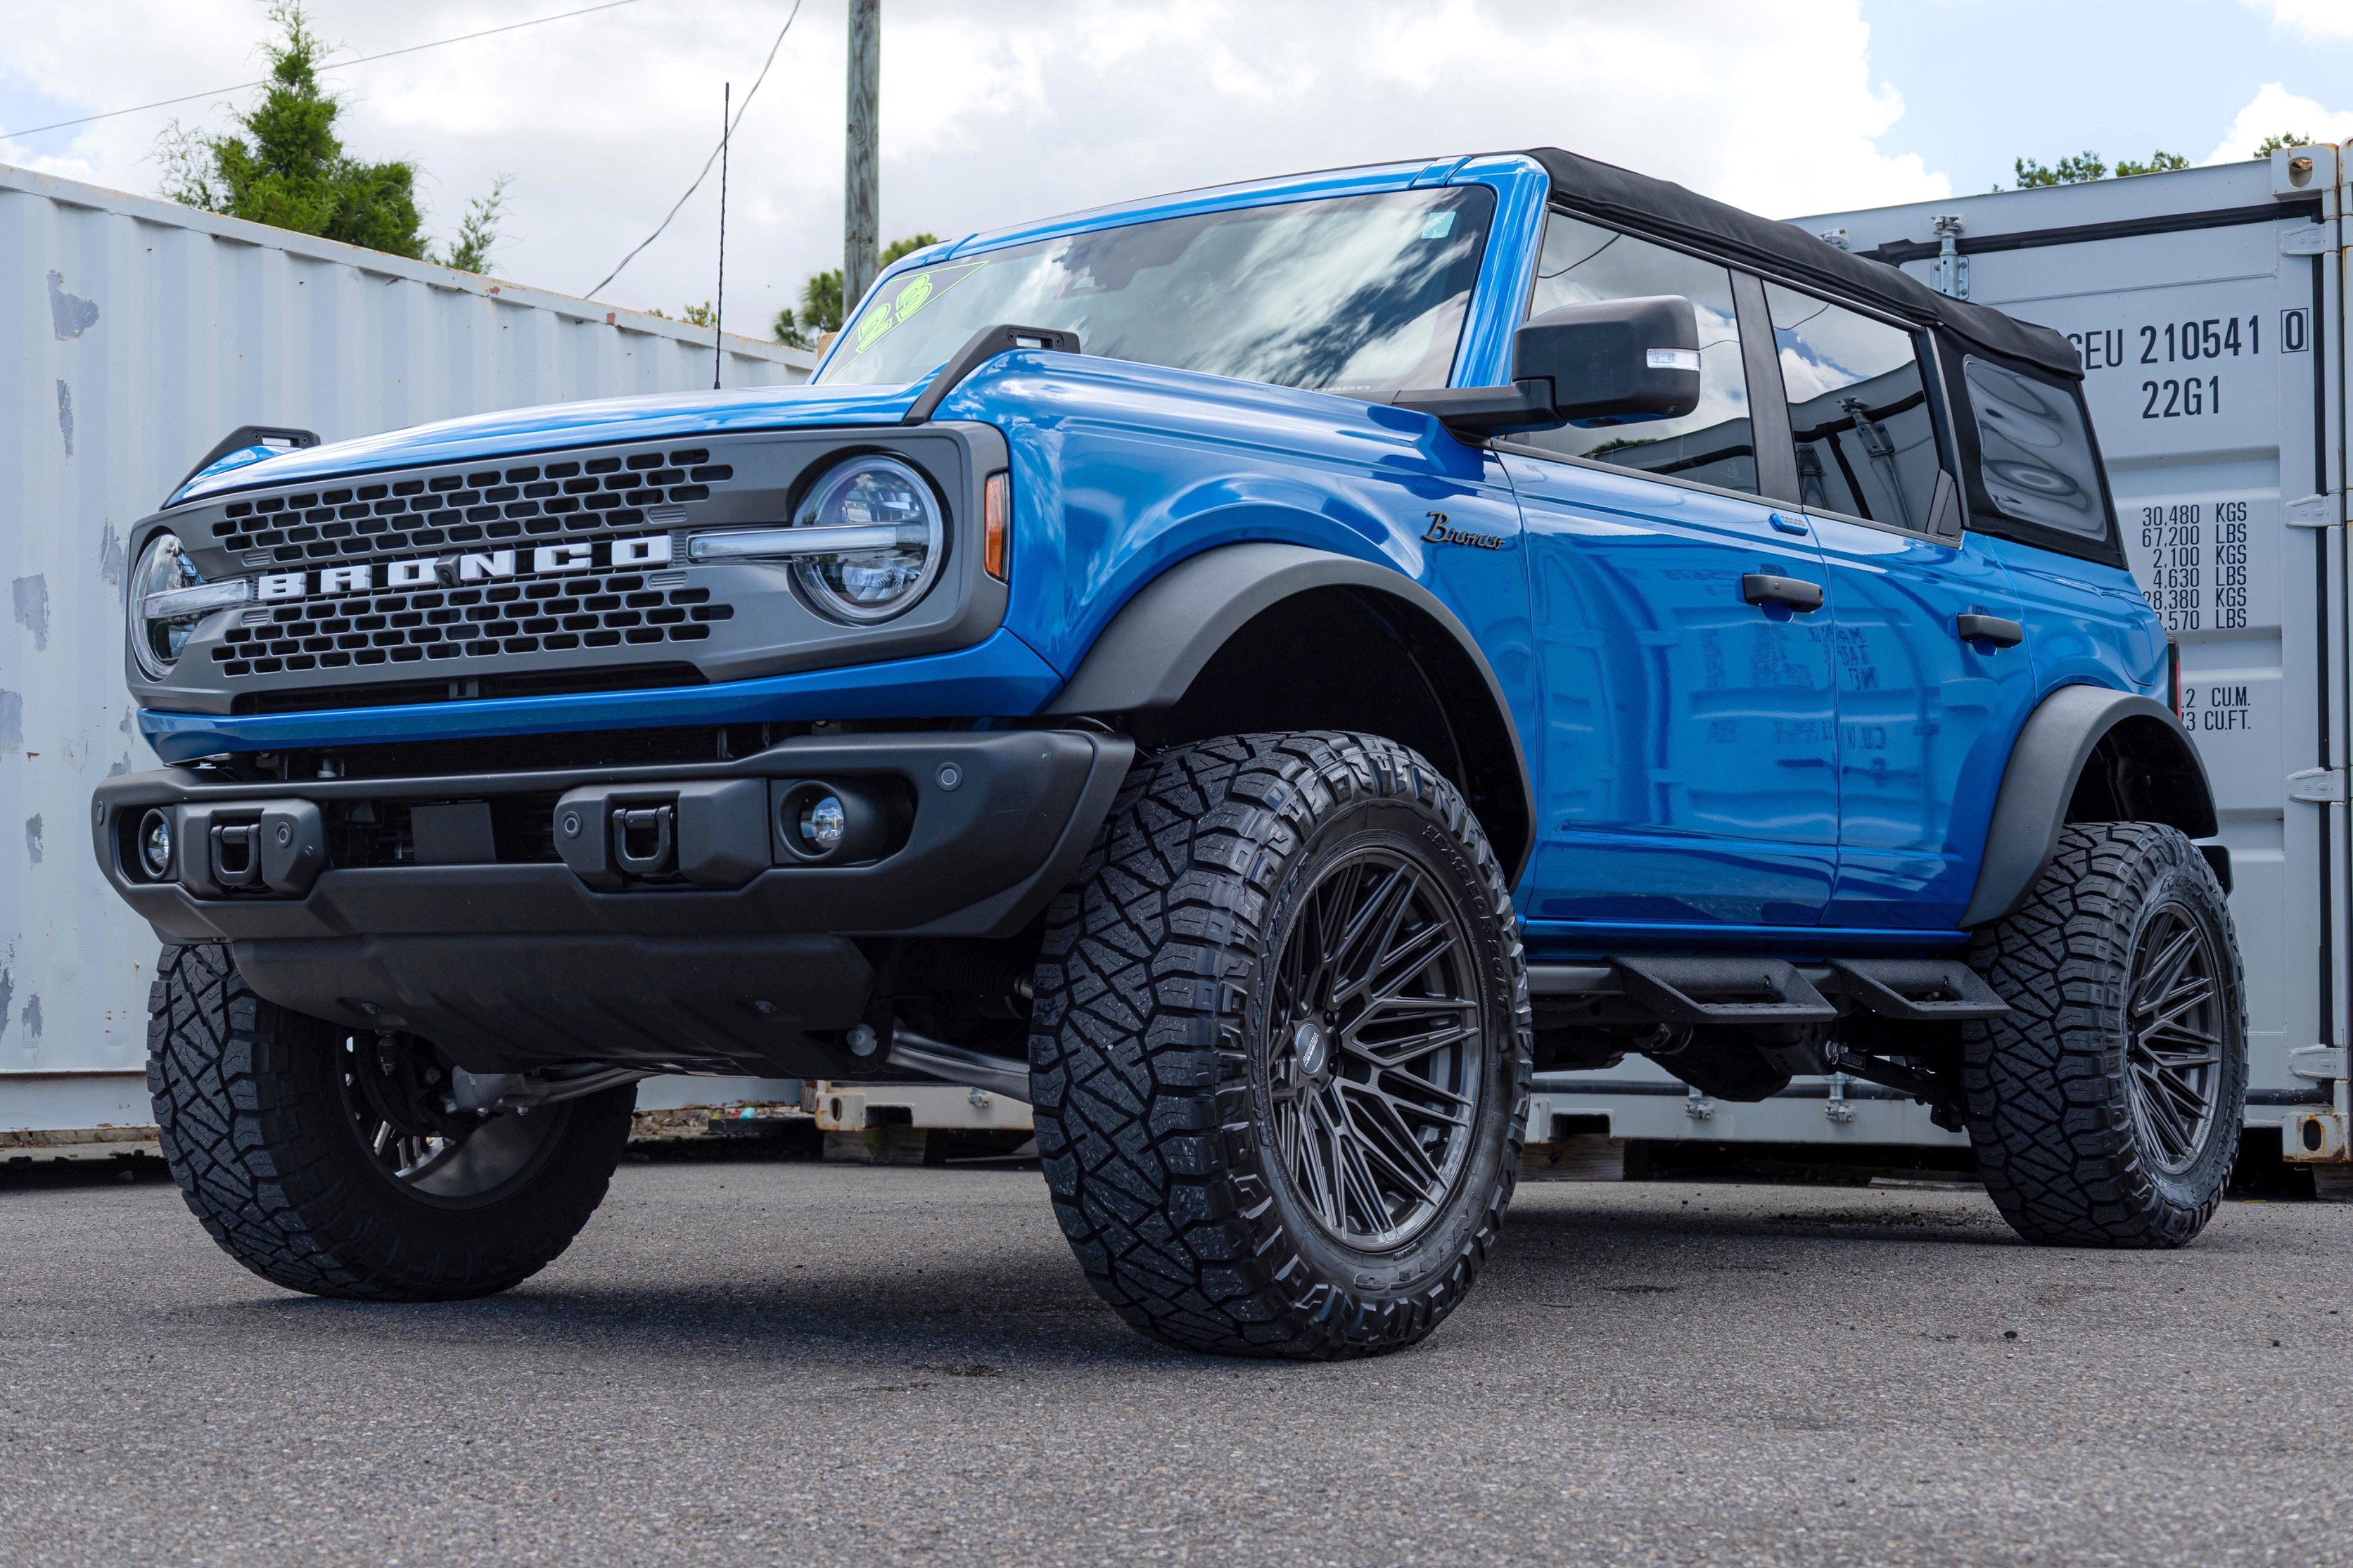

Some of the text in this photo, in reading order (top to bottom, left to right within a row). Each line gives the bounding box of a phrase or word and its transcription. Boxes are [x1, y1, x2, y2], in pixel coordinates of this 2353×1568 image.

[2140, 314, 2259, 365] 210541
[2285, 310, 2305, 351] 0
[2142, 375, 2219, 419] 22G1
[2142, 502, 2247, 527] 30,480 KGS
[1420, 510, 1506, 550] Bronco
[2142, 523, 2247, 547] 67,200 LBS
[258, 535, 672, 600] BRONCO
[2153, 544, 2247, 569] 2,100 KGS
[2153, 566, 2247, 589] 4,630 LBS
[2216, 587, 2247, 608] KGS
[2216, 608, 2247, 629] LBS
[2211, 686, 2251, 707] CU.M.
[2205, 709, 2252, 731] CU.FT.
